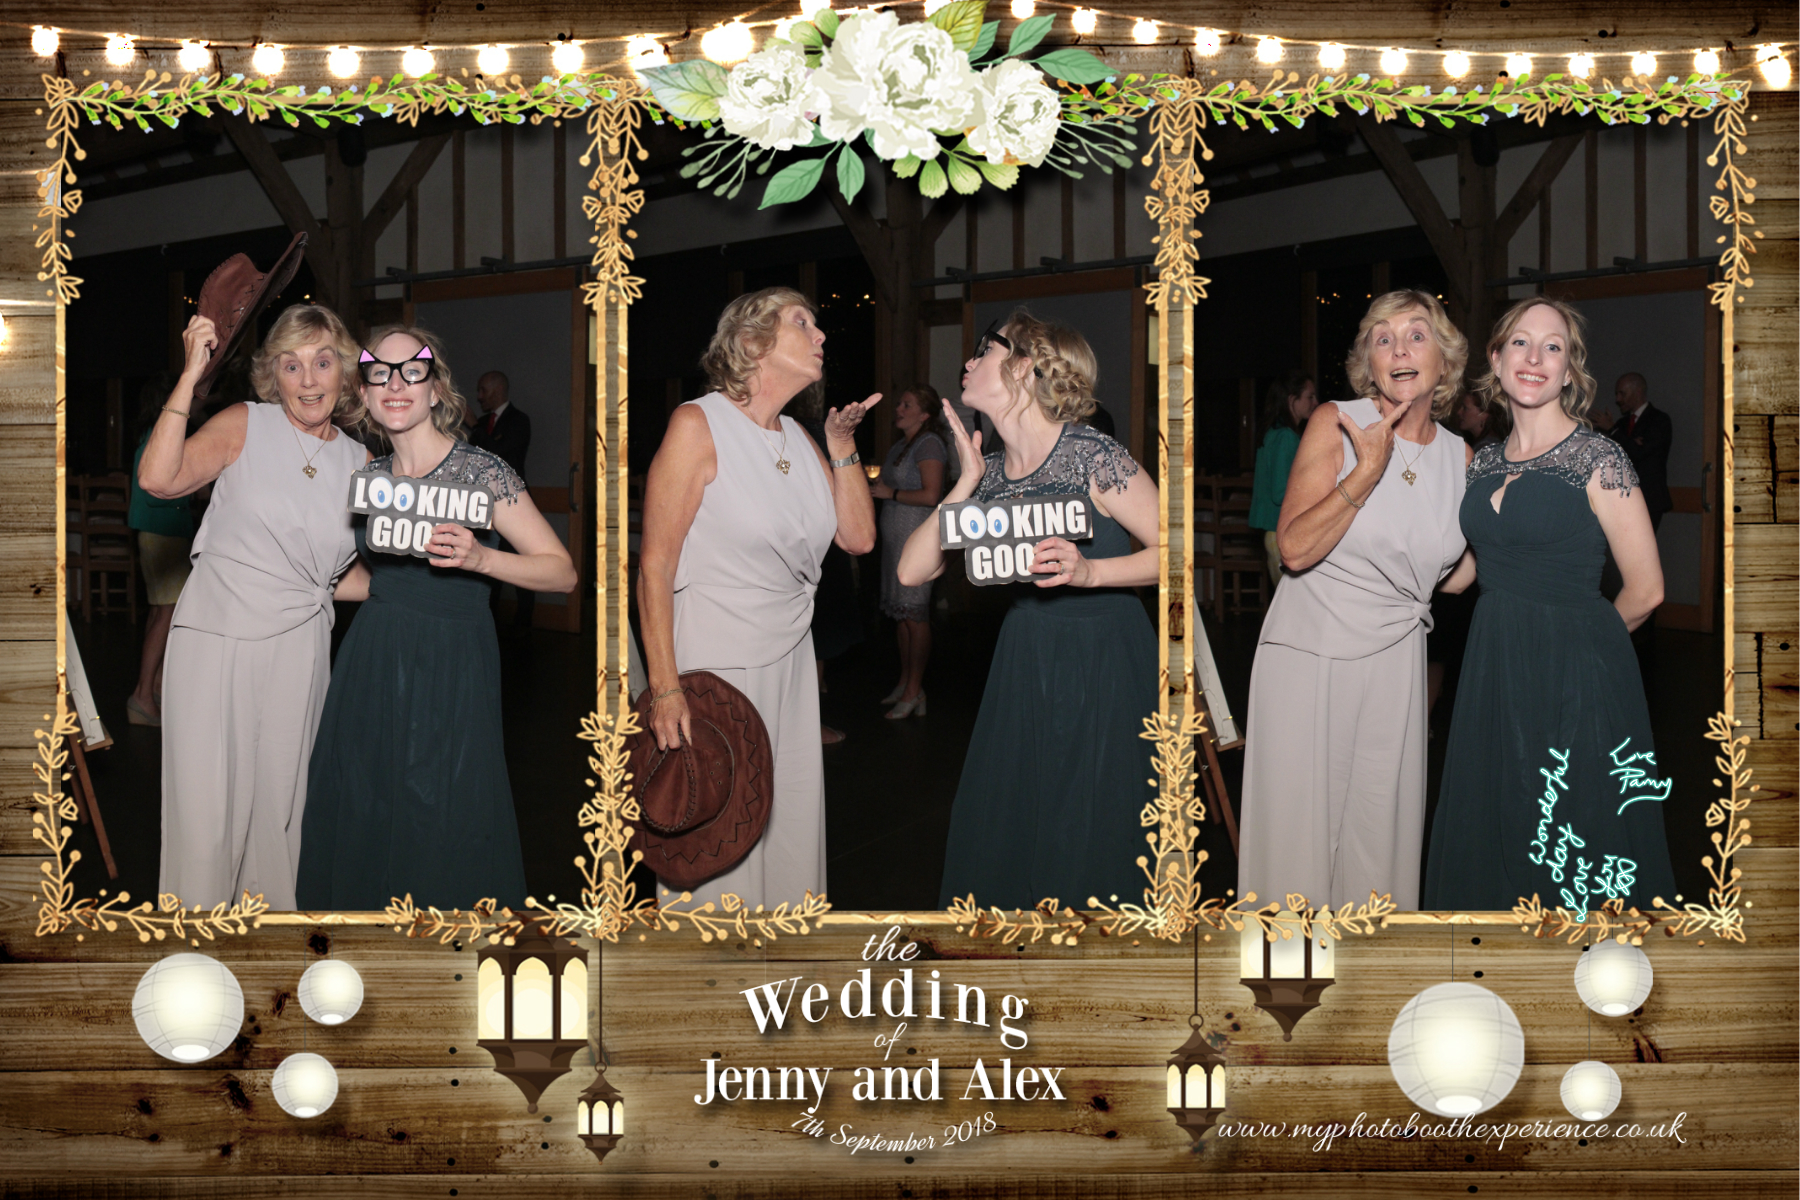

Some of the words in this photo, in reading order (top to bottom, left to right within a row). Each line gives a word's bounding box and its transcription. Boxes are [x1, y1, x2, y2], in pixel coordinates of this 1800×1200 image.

[354, 477, 489, 523] LOOKING
[372, 515, 443, 552] GOO
[945, 500, 1087, 543] LOOKING
[972, 542, 1040, 580] GOO
